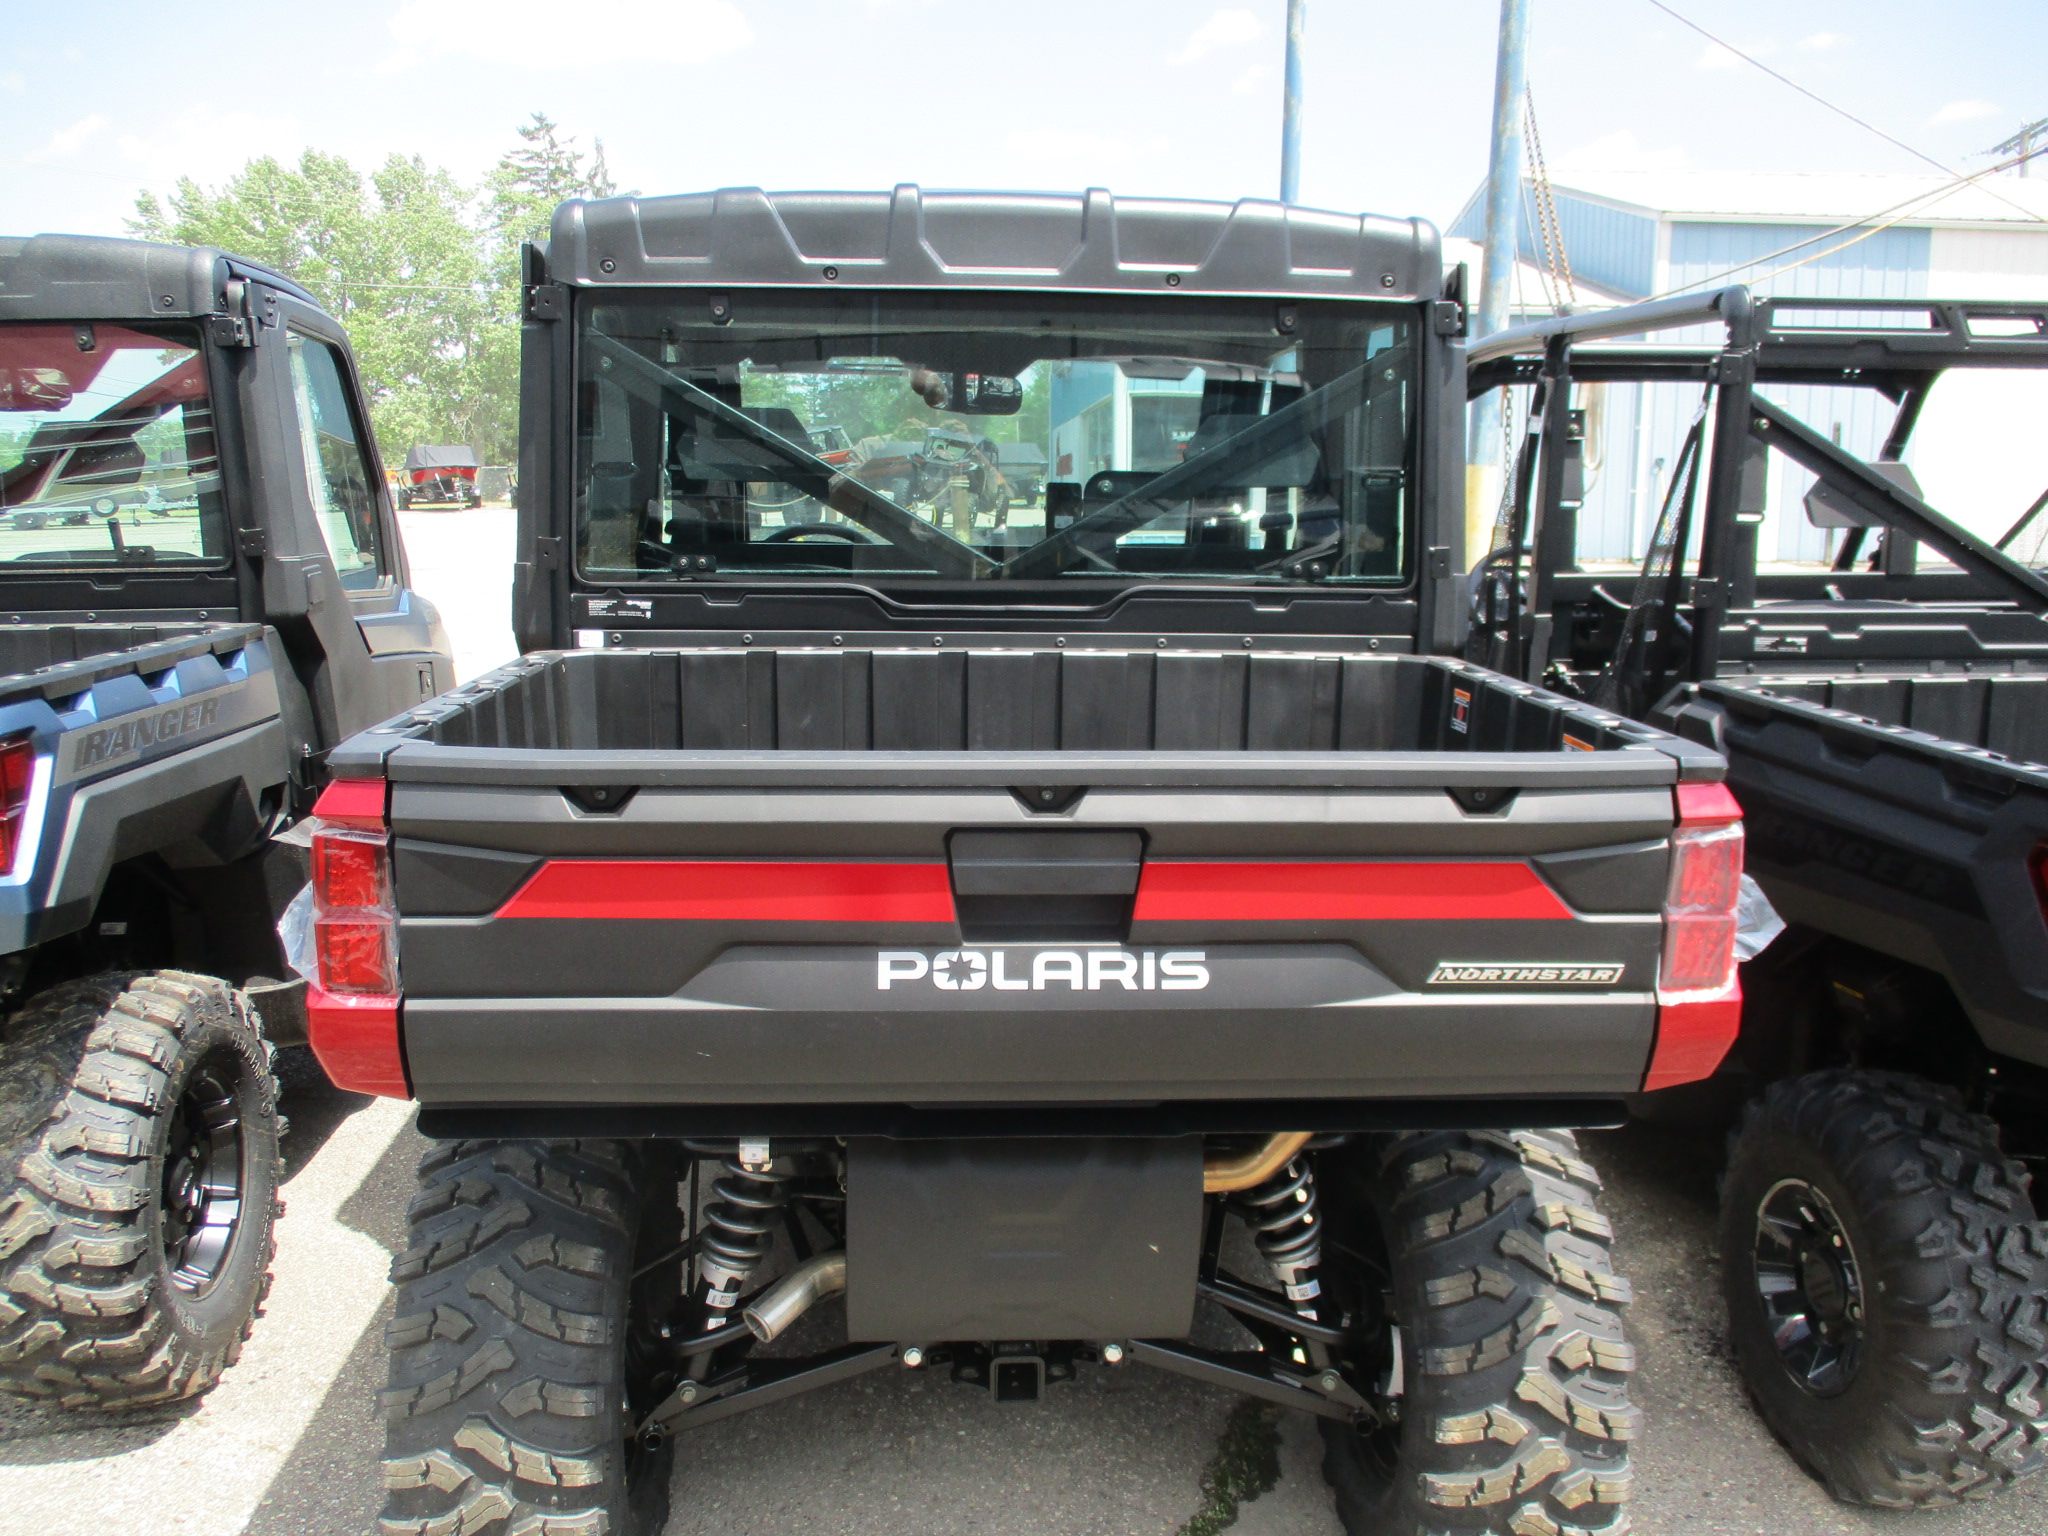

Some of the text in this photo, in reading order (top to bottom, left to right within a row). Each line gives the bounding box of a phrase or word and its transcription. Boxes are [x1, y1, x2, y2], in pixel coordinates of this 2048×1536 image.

[78, 697, 221, 769] RANGER
[877, 951, 1210, 991] POLARIS
[1439, 967, 1615, 982] NORTHSTAR
